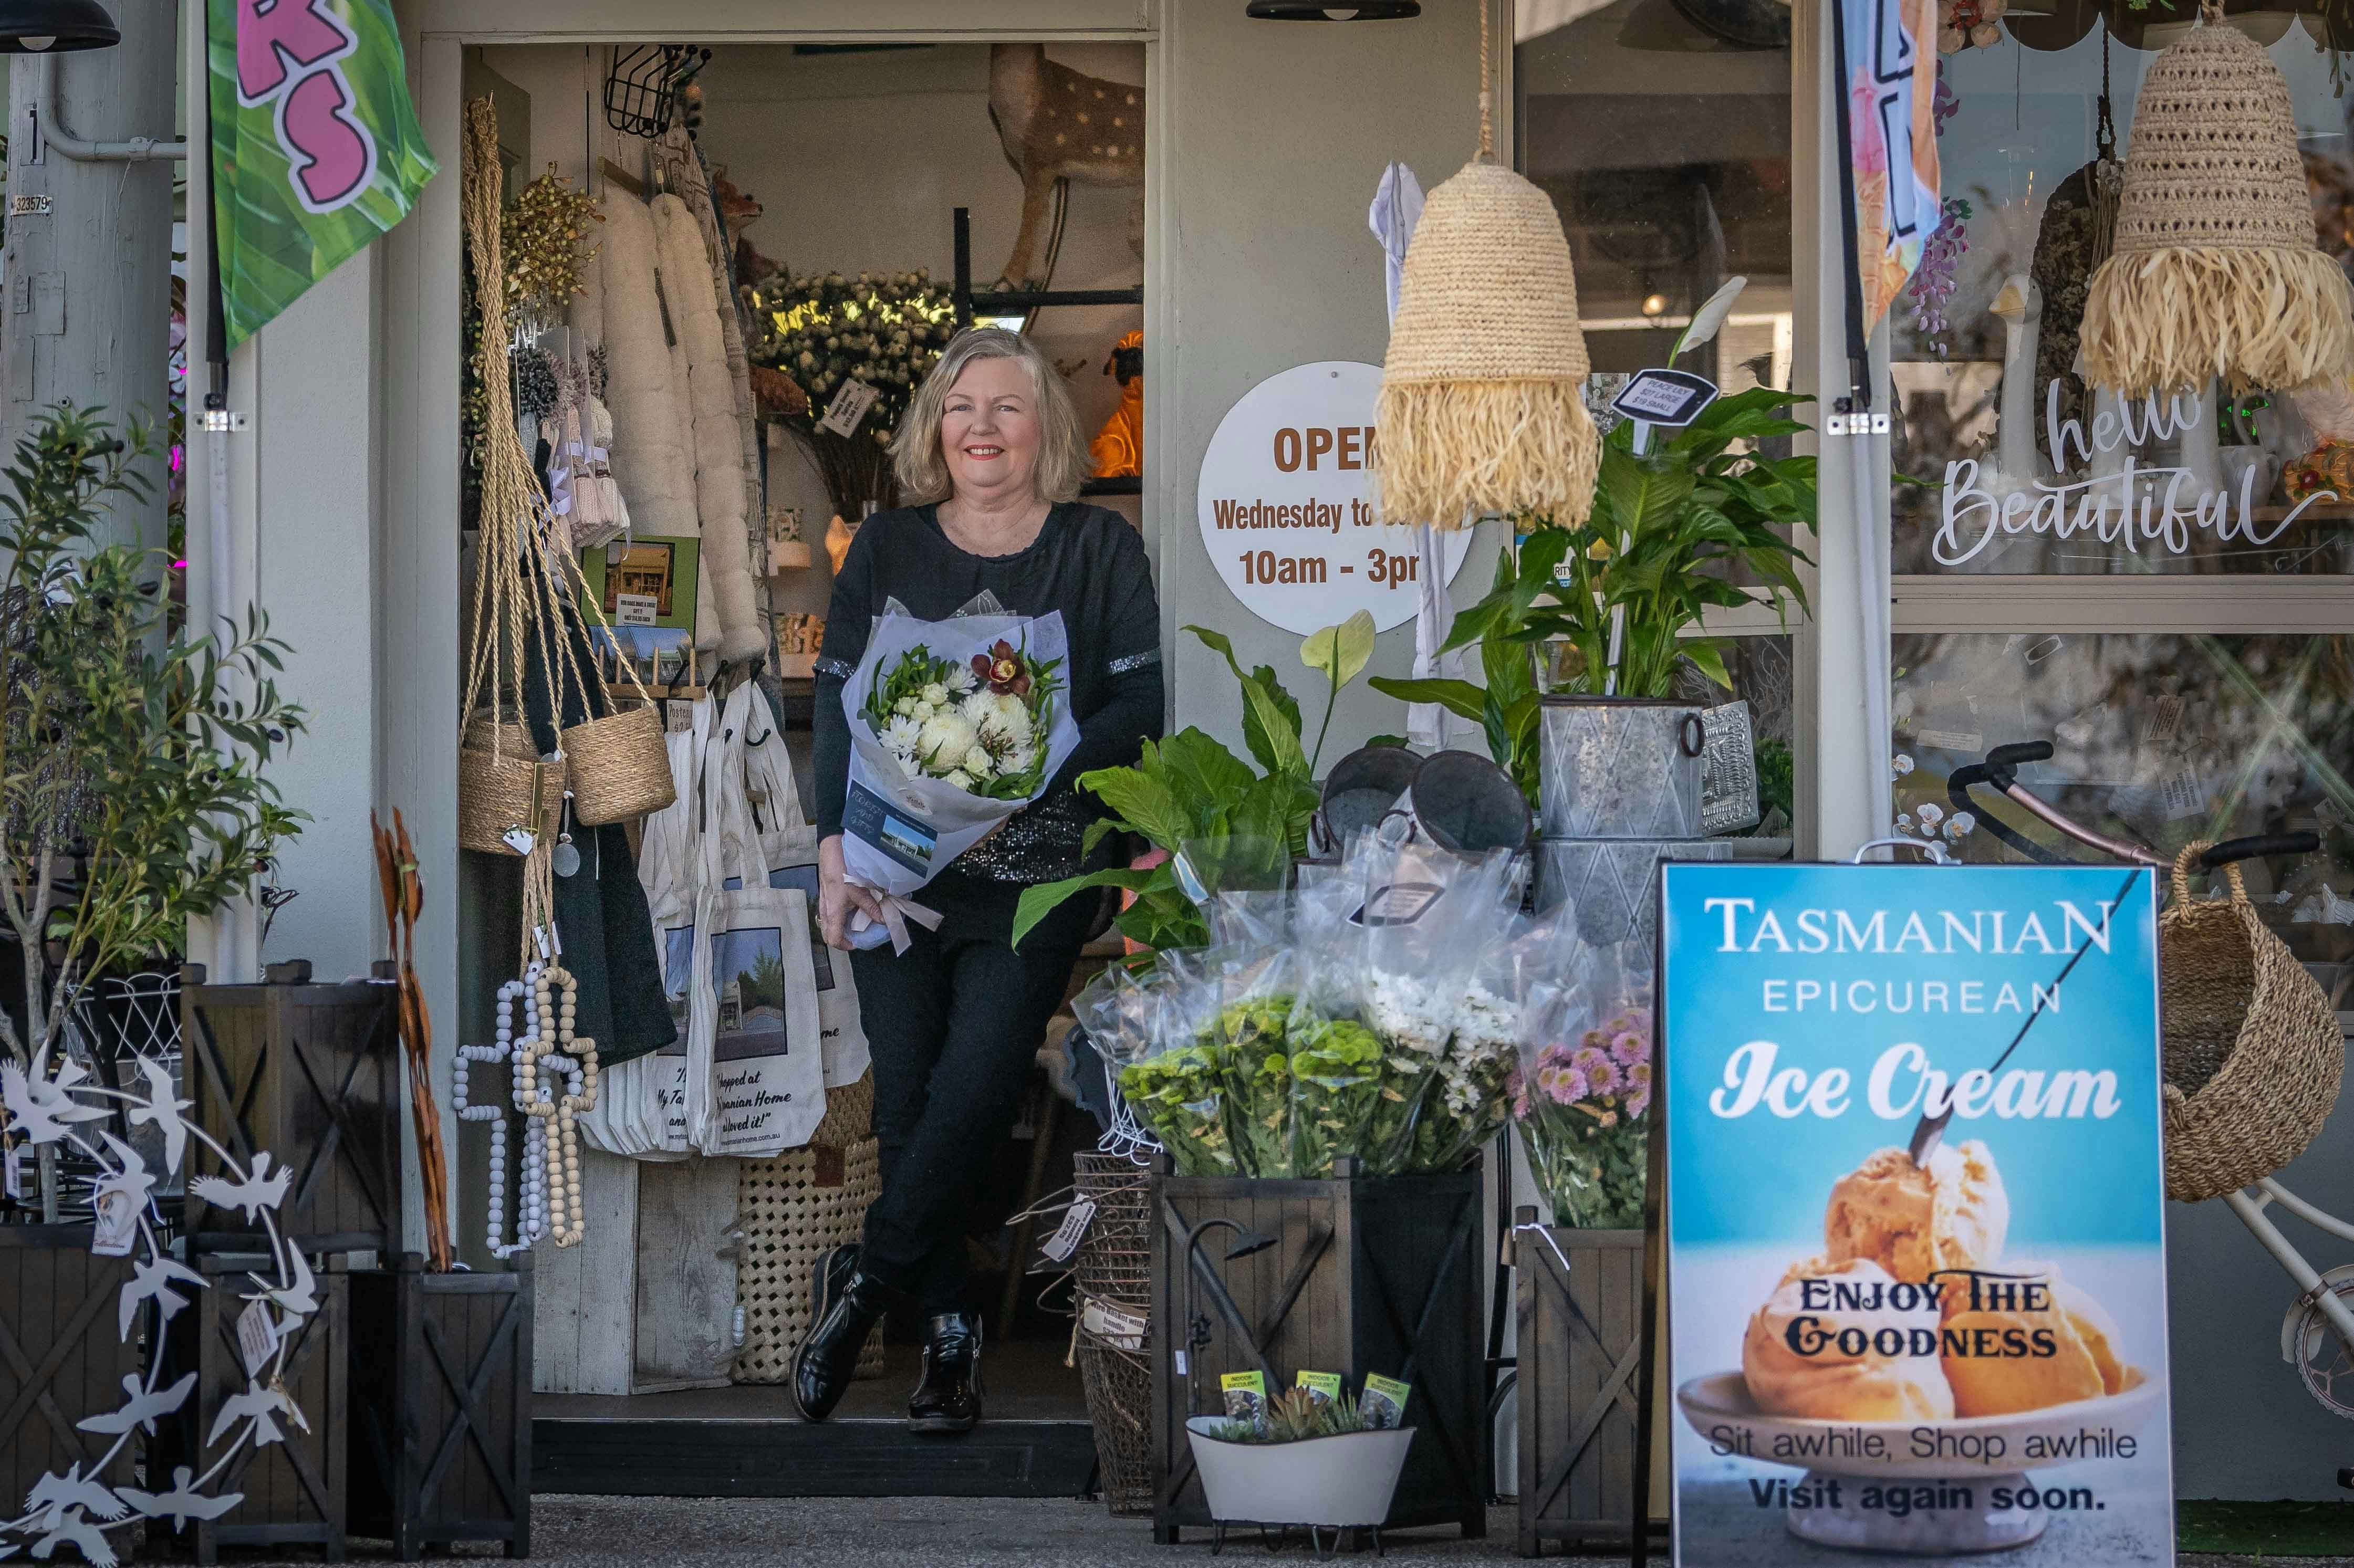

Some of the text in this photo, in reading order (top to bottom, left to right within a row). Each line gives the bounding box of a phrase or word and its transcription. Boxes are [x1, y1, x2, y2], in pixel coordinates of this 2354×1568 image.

[16, 196, 48, 211] 323579
[1213, 497, 1372, 534] Wednesday to
[1932, 456, 2339, 567] Beautiful
[1240, 550, 1327, 584] 10am
[1704, 897, 2115, 954] TASMANIAN
[1763, 980, 2060, 1013] EPICUREAN
[820, 1027, 840, 1039] me
[748, 1070, 762, 1084] at
[1709, 1040, 2120, 1120] Ice Cream
[658, 1089, 669, 1110] My
[754, 1090, 791, 1107] Home
[1091, 1302, 1144, 1329] Wire Basket with
[1103, 1316, 1126, 1332] handle
[1710, 1425, 2138, 1465] Sit awhile, Shop awhile
[1749, 1478, 2106, 1515] Visit again soon.
